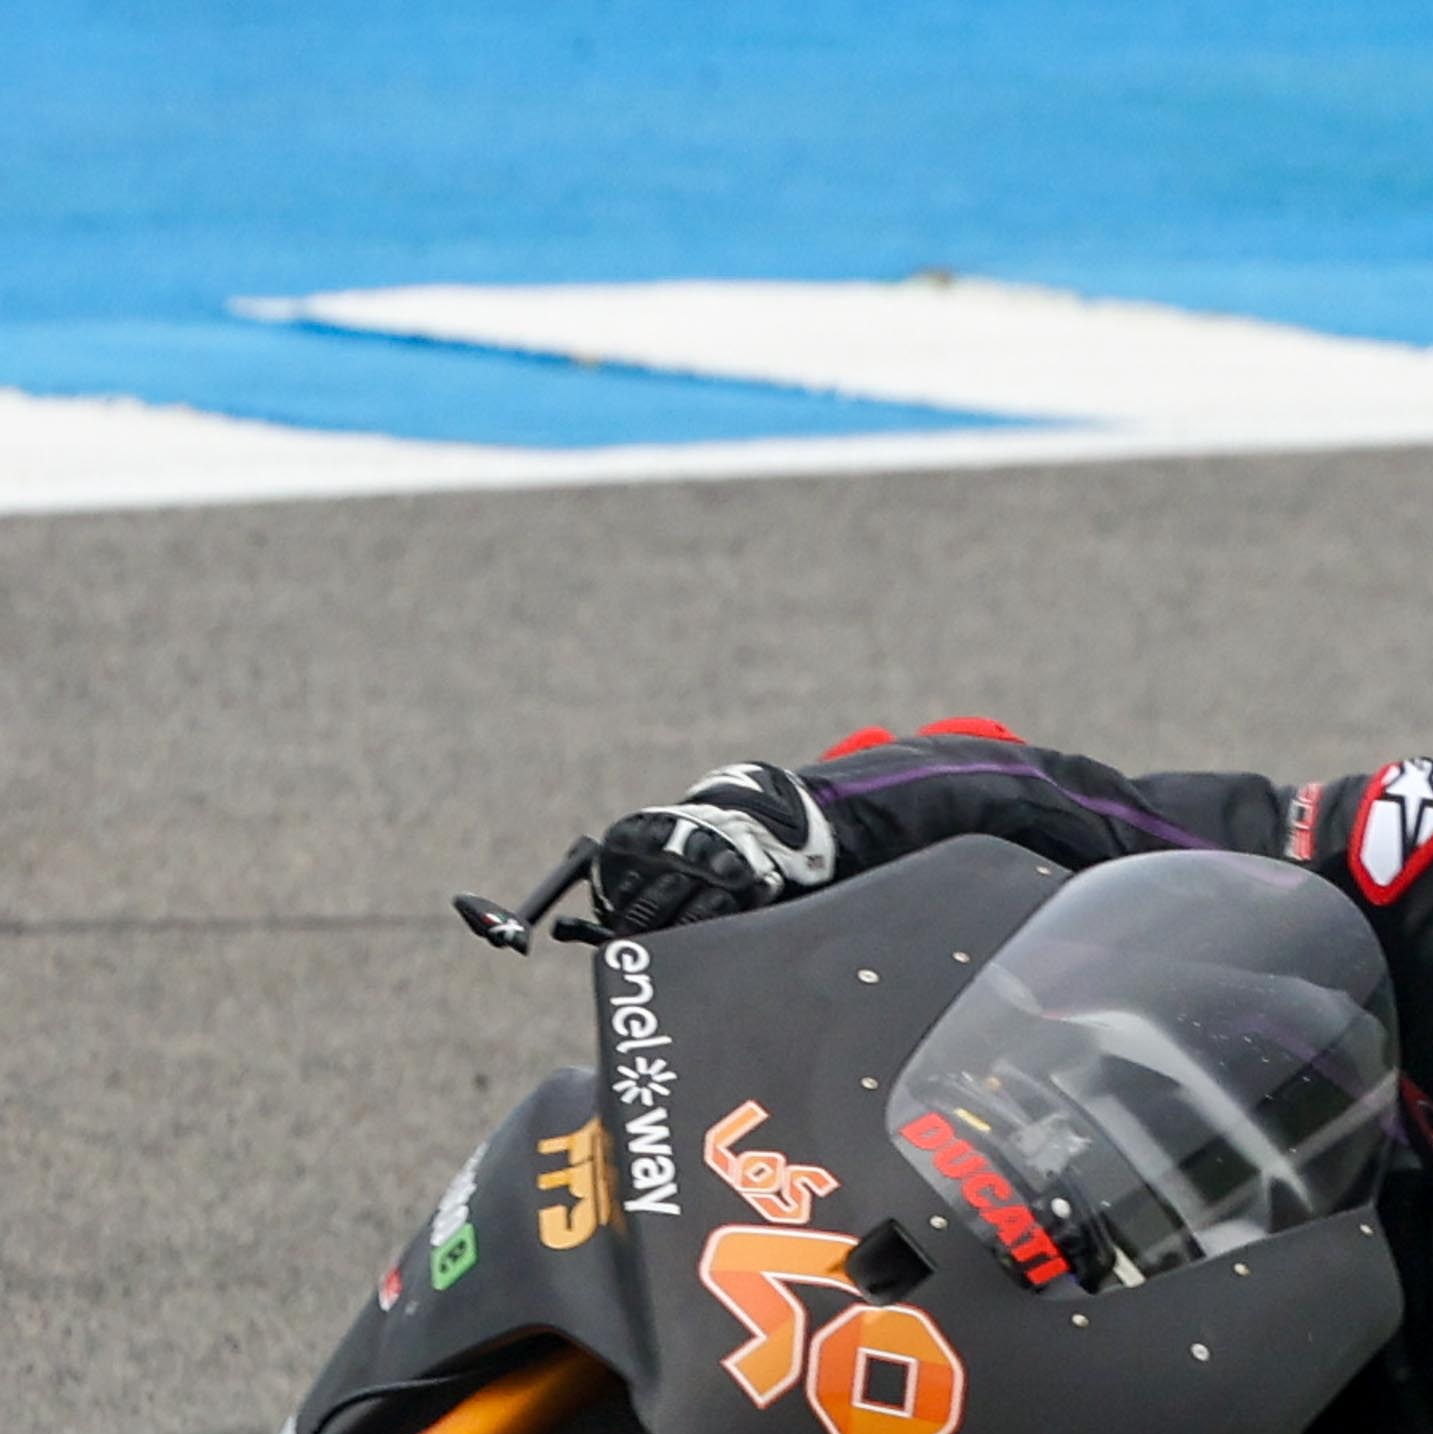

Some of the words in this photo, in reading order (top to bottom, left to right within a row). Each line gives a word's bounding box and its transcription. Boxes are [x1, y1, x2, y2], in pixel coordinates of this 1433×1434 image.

[605, 939, 675, 1055] enel
[624, 1107, 681, 1216] way
[899, 1111, 1073, 1286] DUCATI
